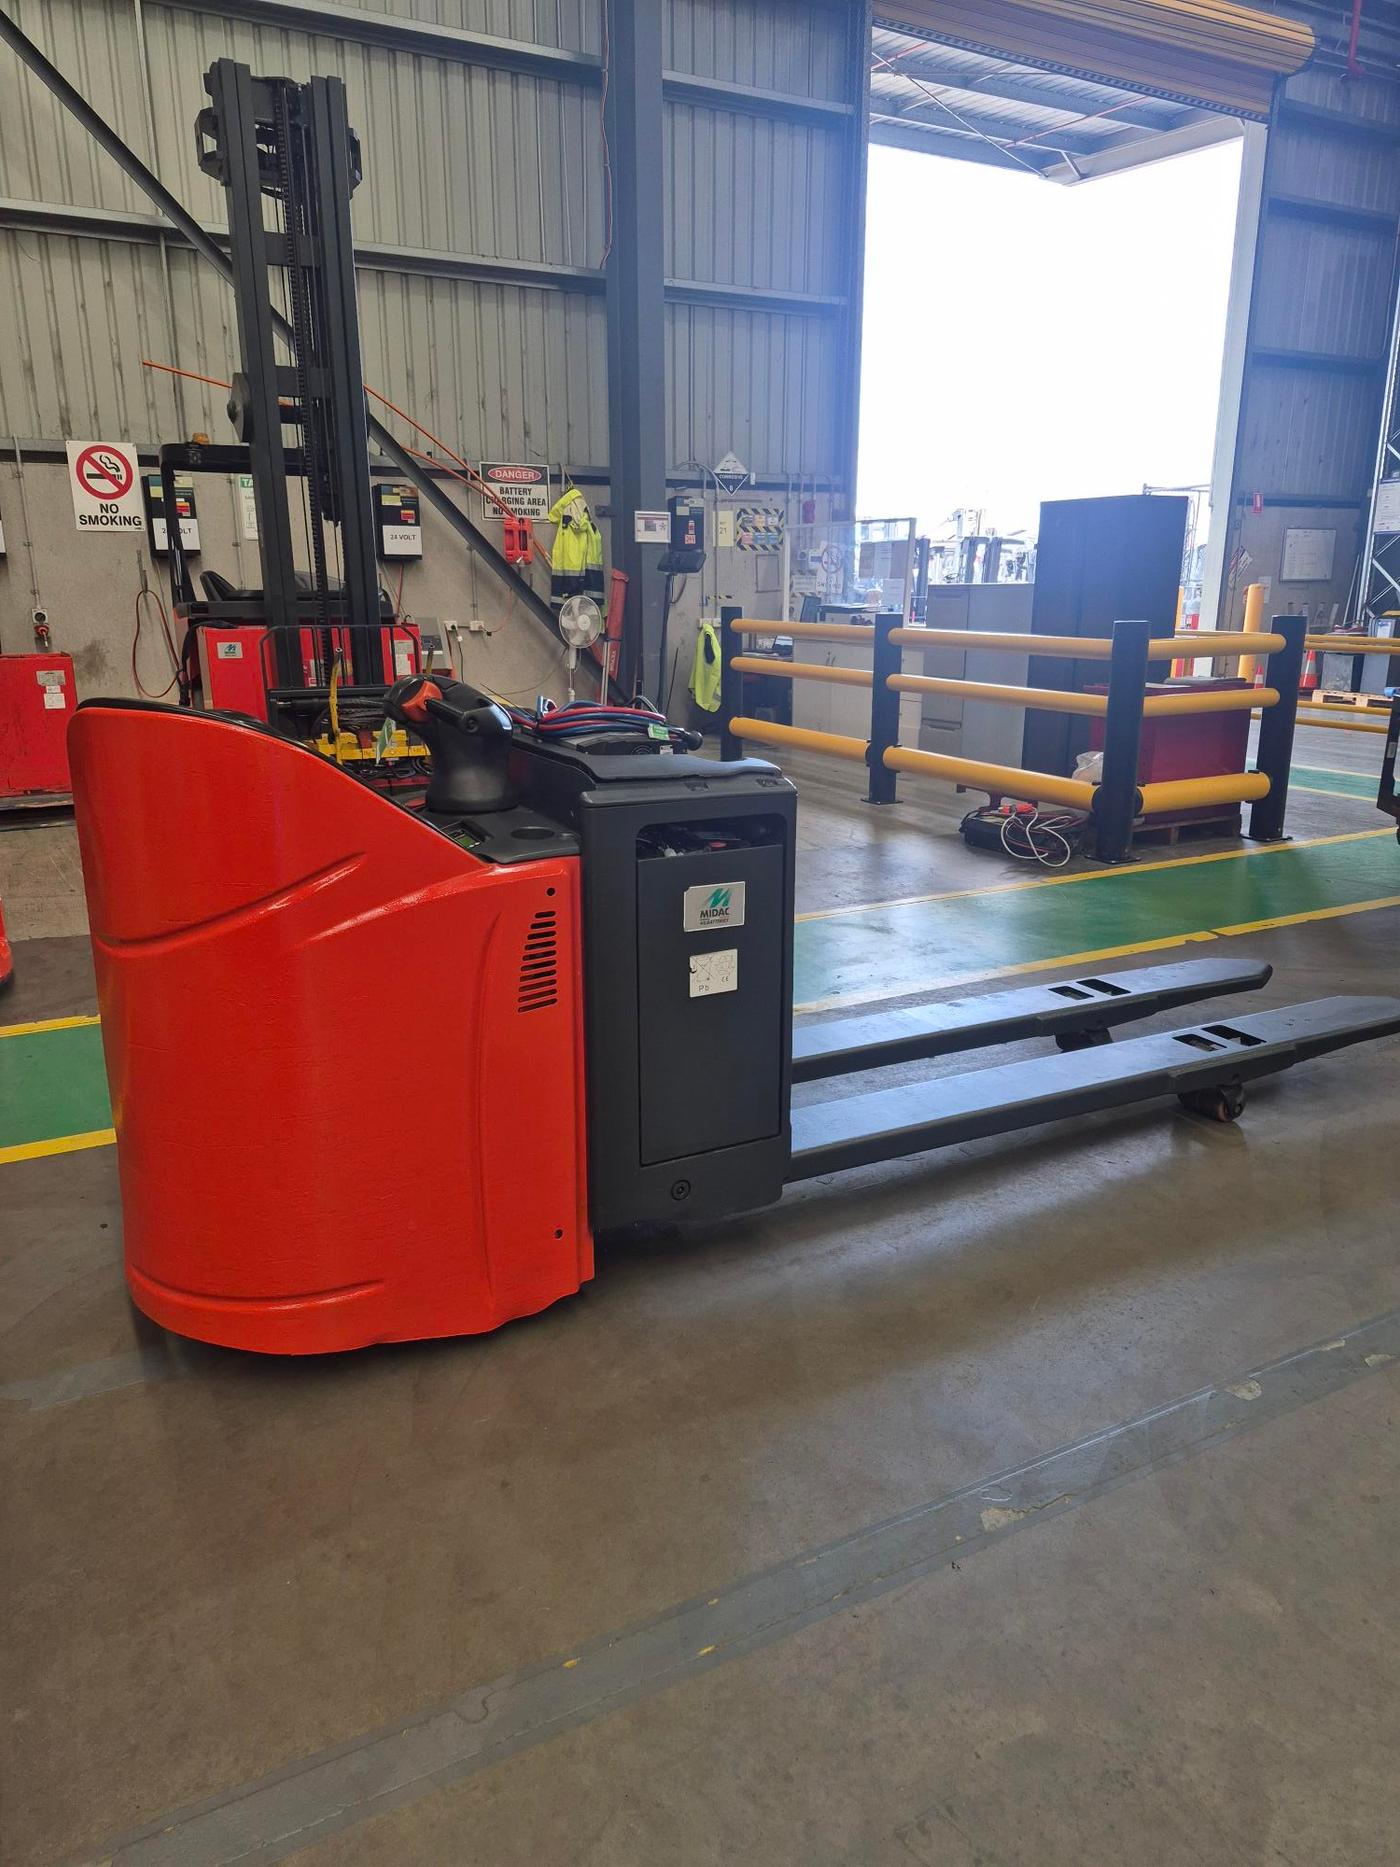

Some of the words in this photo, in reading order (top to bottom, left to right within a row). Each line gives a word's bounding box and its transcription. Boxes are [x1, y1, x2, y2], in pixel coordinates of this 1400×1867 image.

[495, 469, 535, 480] DANGER
[499, 487, 532, 496] BATTERY
[485, 496, 525, 506] CRGING
[527, 498, 547, 506] AREA
[99, 503, 119, 514] NO
[510, 507, 541, 516] MOKING
[79, 515, 142, 526] SMOKING
[699, 907, 731, 919] MIDAC
